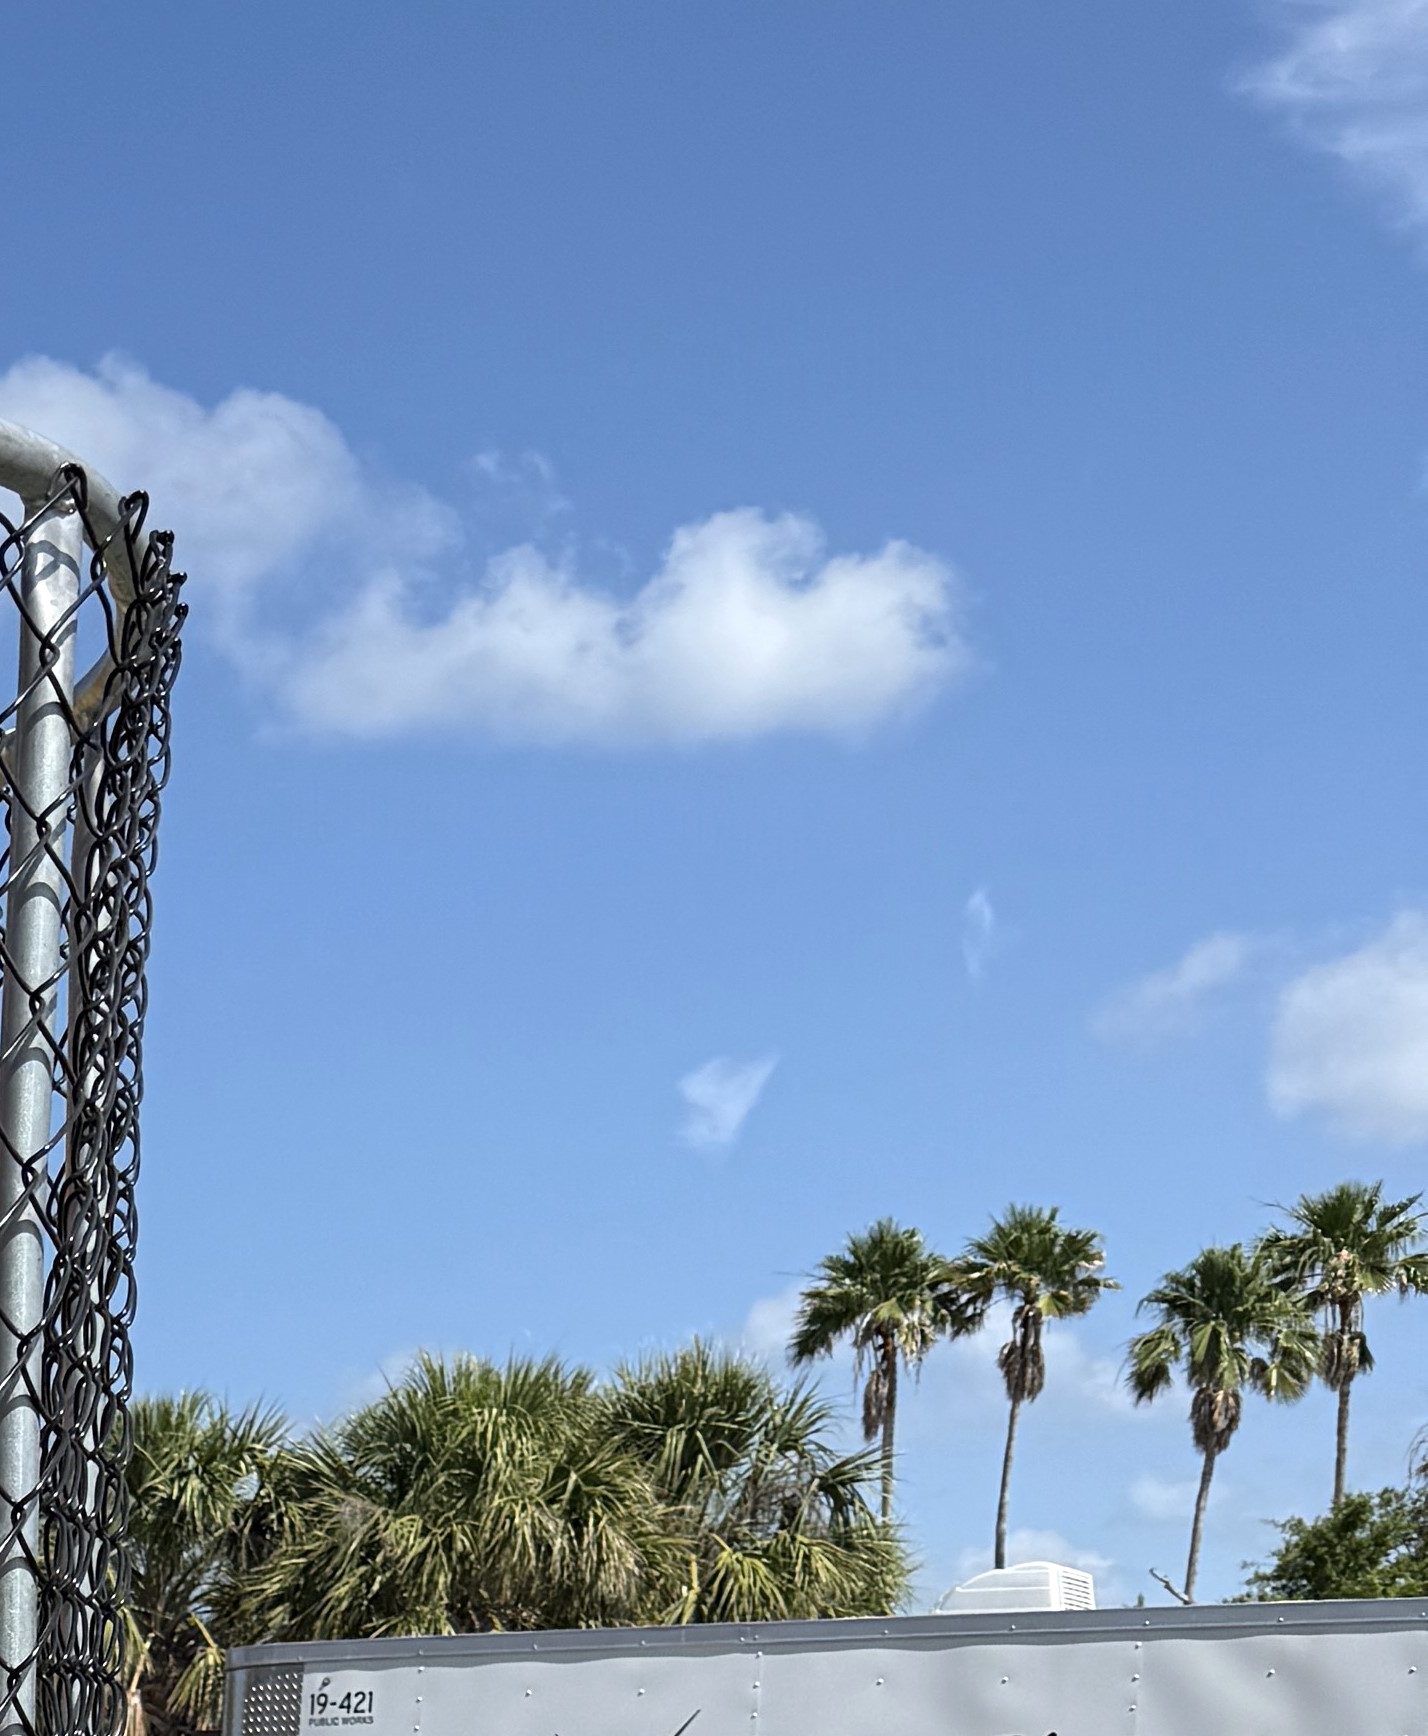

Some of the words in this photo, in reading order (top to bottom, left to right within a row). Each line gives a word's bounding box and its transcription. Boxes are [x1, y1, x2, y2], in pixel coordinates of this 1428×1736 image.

[310, 1690, 373, 1715] 19-421
[308, 1717, 339, 1727] PUBLIC
[341, 1716, 374, 1726] WORKS
